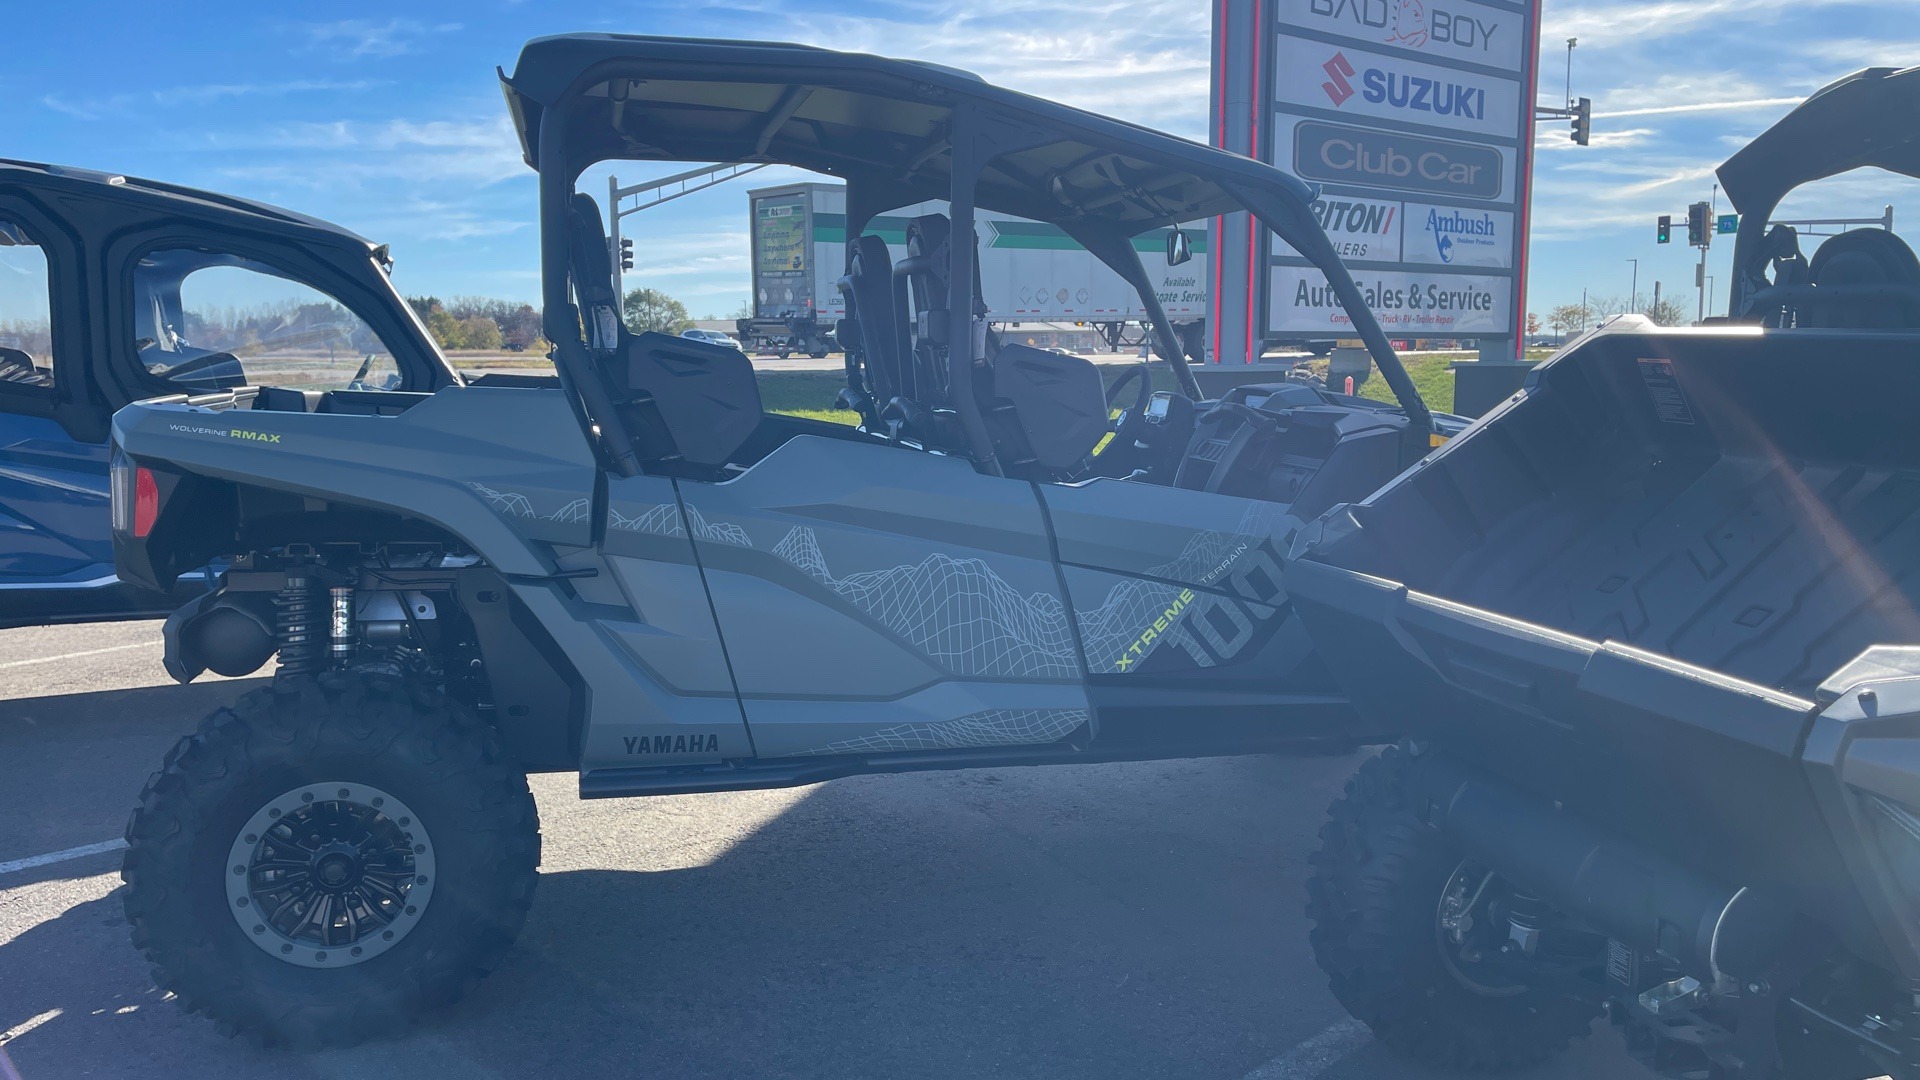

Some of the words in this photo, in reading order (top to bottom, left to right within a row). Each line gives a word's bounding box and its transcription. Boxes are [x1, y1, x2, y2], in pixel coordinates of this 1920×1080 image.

[1431, 9, 1498, 51] BOY
[1362, 68, 1485, 120] SUZUKI
[1320, 139, 1413, 177] Club
[1417, 152, 1482, 185] Car
[1310, 199, 1387, 233] RITON
[1425, 208, 1495, 236] Ambush
[1163, 277, 1196, 287] Available
[1181, 290, 1206, 302] Servic
[1354, 281, 1403, 309] ales
[1408, 283, 1422, 310] &
[1427, 284, 1492, 311] Service
[1382, 314, 1399, 323] Truck
[1402, 314, 1412, 323] RV
[1416, 315, 1435, 324] Trailer
[1435, 315, 1455, 326] Repair
[169, 424, 227, 437] WOLVERINE
[230, 429, 281, 443] RMAX
[1115, 588, 1195, 672] XTREME
[1200, 542, 1248, 584] TERRAIN
[623, 734, 719, 754] YAMAHA
